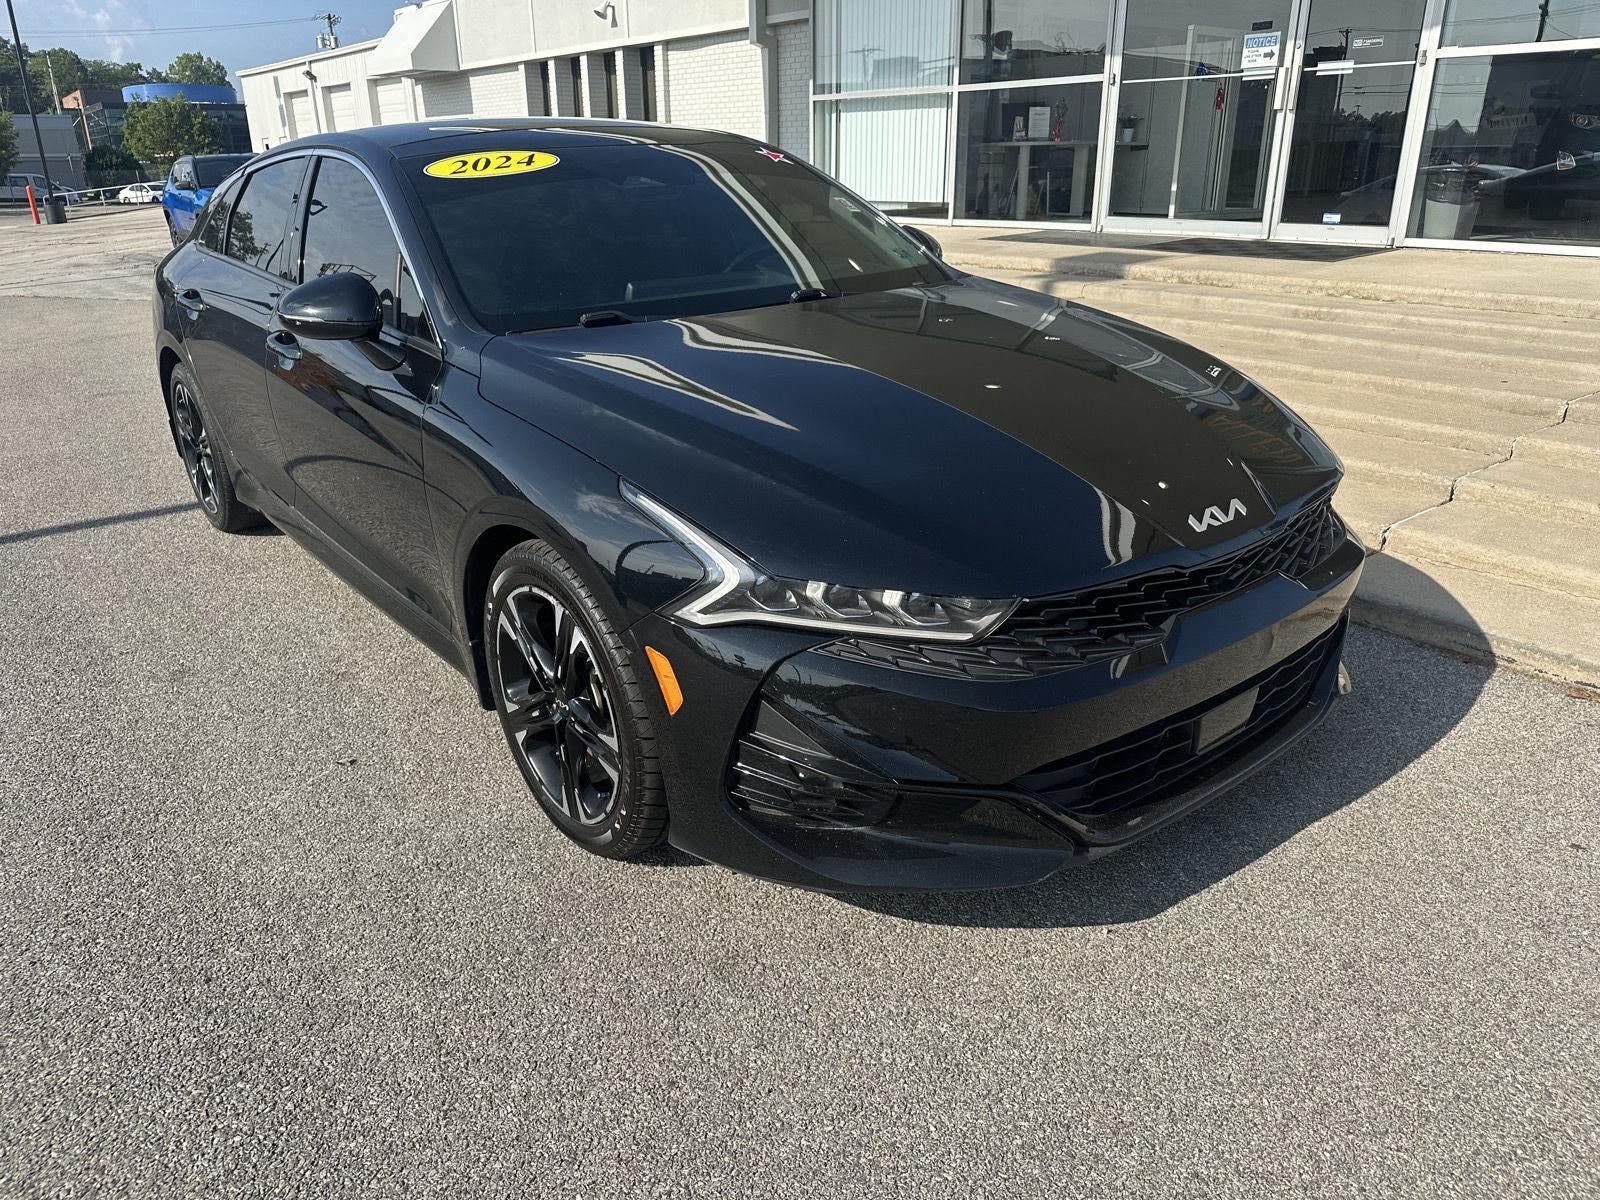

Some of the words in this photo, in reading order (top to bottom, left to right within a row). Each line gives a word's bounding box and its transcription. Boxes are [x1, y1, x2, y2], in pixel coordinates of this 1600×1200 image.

[1247, 36, 1277, 48] NOTICE
[449, 153, 535, 174] 2024
[1188, 498, 1247, 532] KIA
